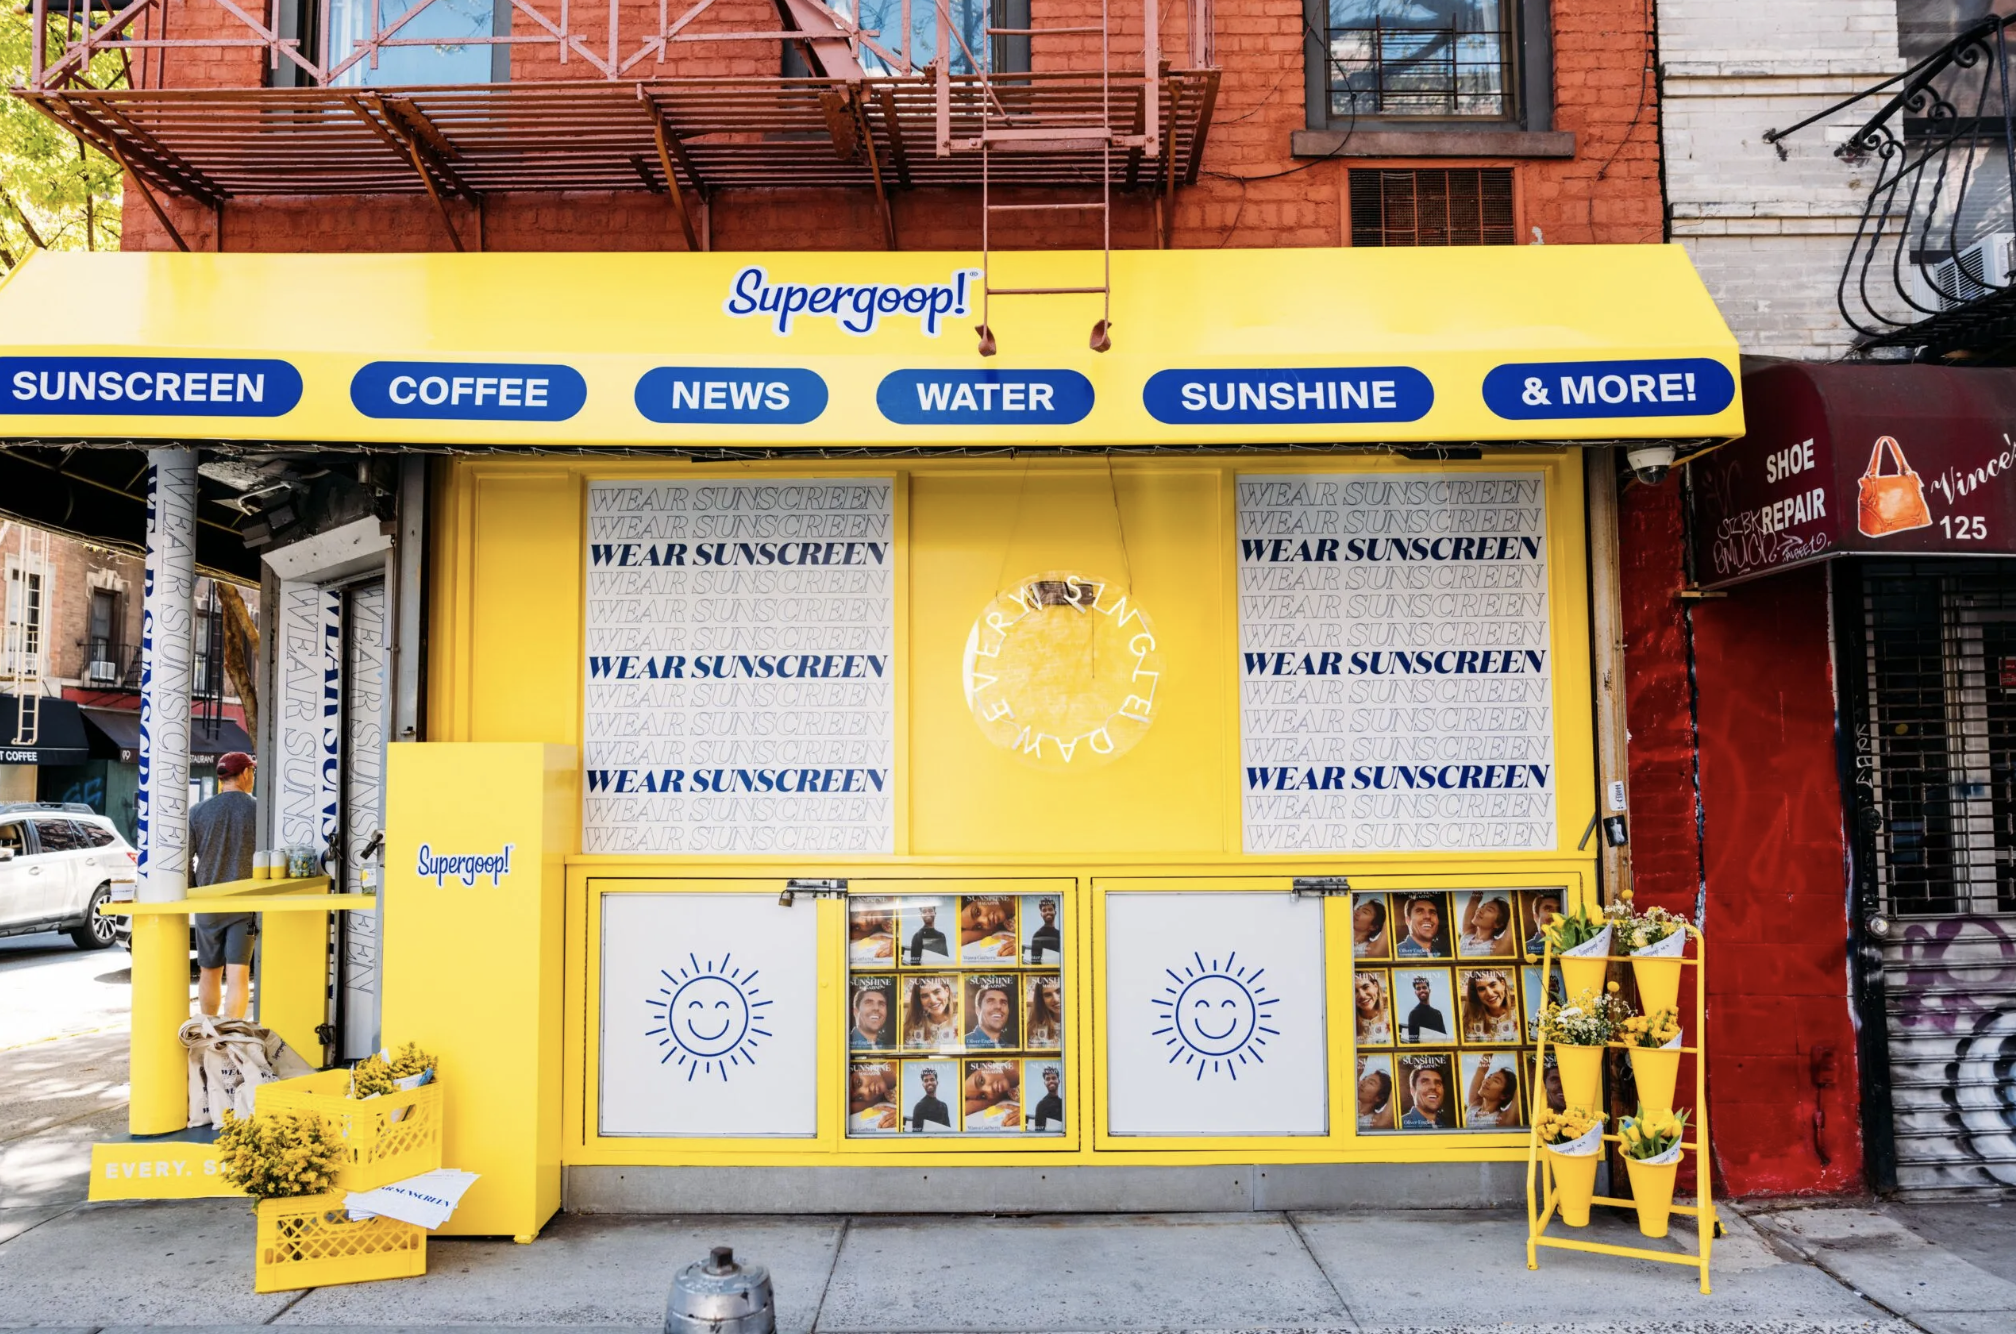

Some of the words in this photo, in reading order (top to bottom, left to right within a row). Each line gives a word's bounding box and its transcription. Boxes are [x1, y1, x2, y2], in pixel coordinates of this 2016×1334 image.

[729, 268, 966, 334] Supergoop!
[12, 371, 265, 402] SUNSCREEN
[389, 376, 549, 407] COFFEE
[672, 381, 790, 410] NEWS
[916, 383, 1055, 411] WATER
[1181, 381, 1397, 410] SUNSHINE
[1522, 378, 1551, 406] &
[1560, 372, 1696, 404] MORE!
[1766, 438, 1815, 483] SHOE
[591, 487, 688, 512] WEAR
[693, 486, 889, 511] SUNSCREEN
[1240, 482, 1338, 506] WEAR
[1343, 480, 1540, 505] SUNSCREEN
[1240, 510, 1339, 534] WEAR
[1344, 508, 1541, 533] SUNSCREEN
[1762, 487, 1826, 535] REPAIR
[160, 467, 196, 600] WEAR
[591, 515, 688, 540] WEAR
[693, 514, 889, 539] SUNSCREEN
[1940, 515, 1988, 540] 125
[591, 543, 687, 567] WEAR
[692, 542, 889, 566] SUNSCREEN
[1241, 538, 1340, 562] WEAR
[1345, 536, 1542, 561] SUNSCREEN
[590, 570, 687, 595] WEAR
[692, 569, 889, 594] SUNSCREEN
[1242, 566, 1340, 591] WEAR
[1345, 564, 1544, 590] SUNSCREEN
[589, 598, 687, 623] WEAR
[691, 597, 889, 622] SUNSCREEN
[1242, 595, 1341, 619] WEAR
[1346, 592, 1545, 619] SUNSCREEN
[589, 627, 686, 652] WEAR
[691, 626, 889, 651] SUNSCREEN
[1243, 623, 1342, 648] WEAR
[1347, 621, 1546, 647] SUNSCREEN
[285, 586, 320, 722] WEAR
[589, 656, 686, 679] WEAR
[691, 655, 888, 679] SUNSCREEN
[1243, 651, 1343, 676] WEAR
[1348, 650, 1546, 675] SUNSCREEN
[588, 683, 685, 708] WEAR
[690, 682, 889, 707] SUNSCREEN
[1244, 680, 1344, 705] WEAR
[1348, 678, 1548, 704] SUNSCREEN
[587, 712, 685, 737] WEAR
[690, 711, 889, 736] SUNSCREEN
[1245, 709, 1344, 733] WEAR
[1349, 706, 1549, 733] SUNSCREEN
[155, 603, 192, 878] SUNSCREEN
[587, 741, 685, 765] WEAR
[689, 740, 889, 765] SUNSCREEN
[1245, 738, 1345, 762] WEAR
[1350, 735, 1550, 762] SUNSCREEN
[5, 750, 38, 762] COFFEE
[587, 769, 685, 793] WEAR
[689, 768, 888, 793] SUNSCREEN
[1246, 766, 1346, 791] WEAR
[1351, 764, 1550, 790] SUNSCREEN
[586, 797, 684, 822] WEAR
[688, 797, 889, 822] SUNSCREEN
[1247, 795, 1347, 820] WEAR
[1351, 793, 1552, 819] SUNSCREEN
[585, 826, 684, 851] WEAR
[689, 826, 889, 851] SUNSCREEN
[1247, 824, 1347, 849] WEAR
[1352, 822, 1553, 848] SUNSCREEN
[418, 844, 508, 886] Supergoop!
[970, 976, 1014, 985] SUNSHINE
[1464, 970, 1508, 979] SUNSHINE
[1402, 1056, 1447, 1065] SUNSHINE
[105, 1160, 193, 1179] EVERY.
